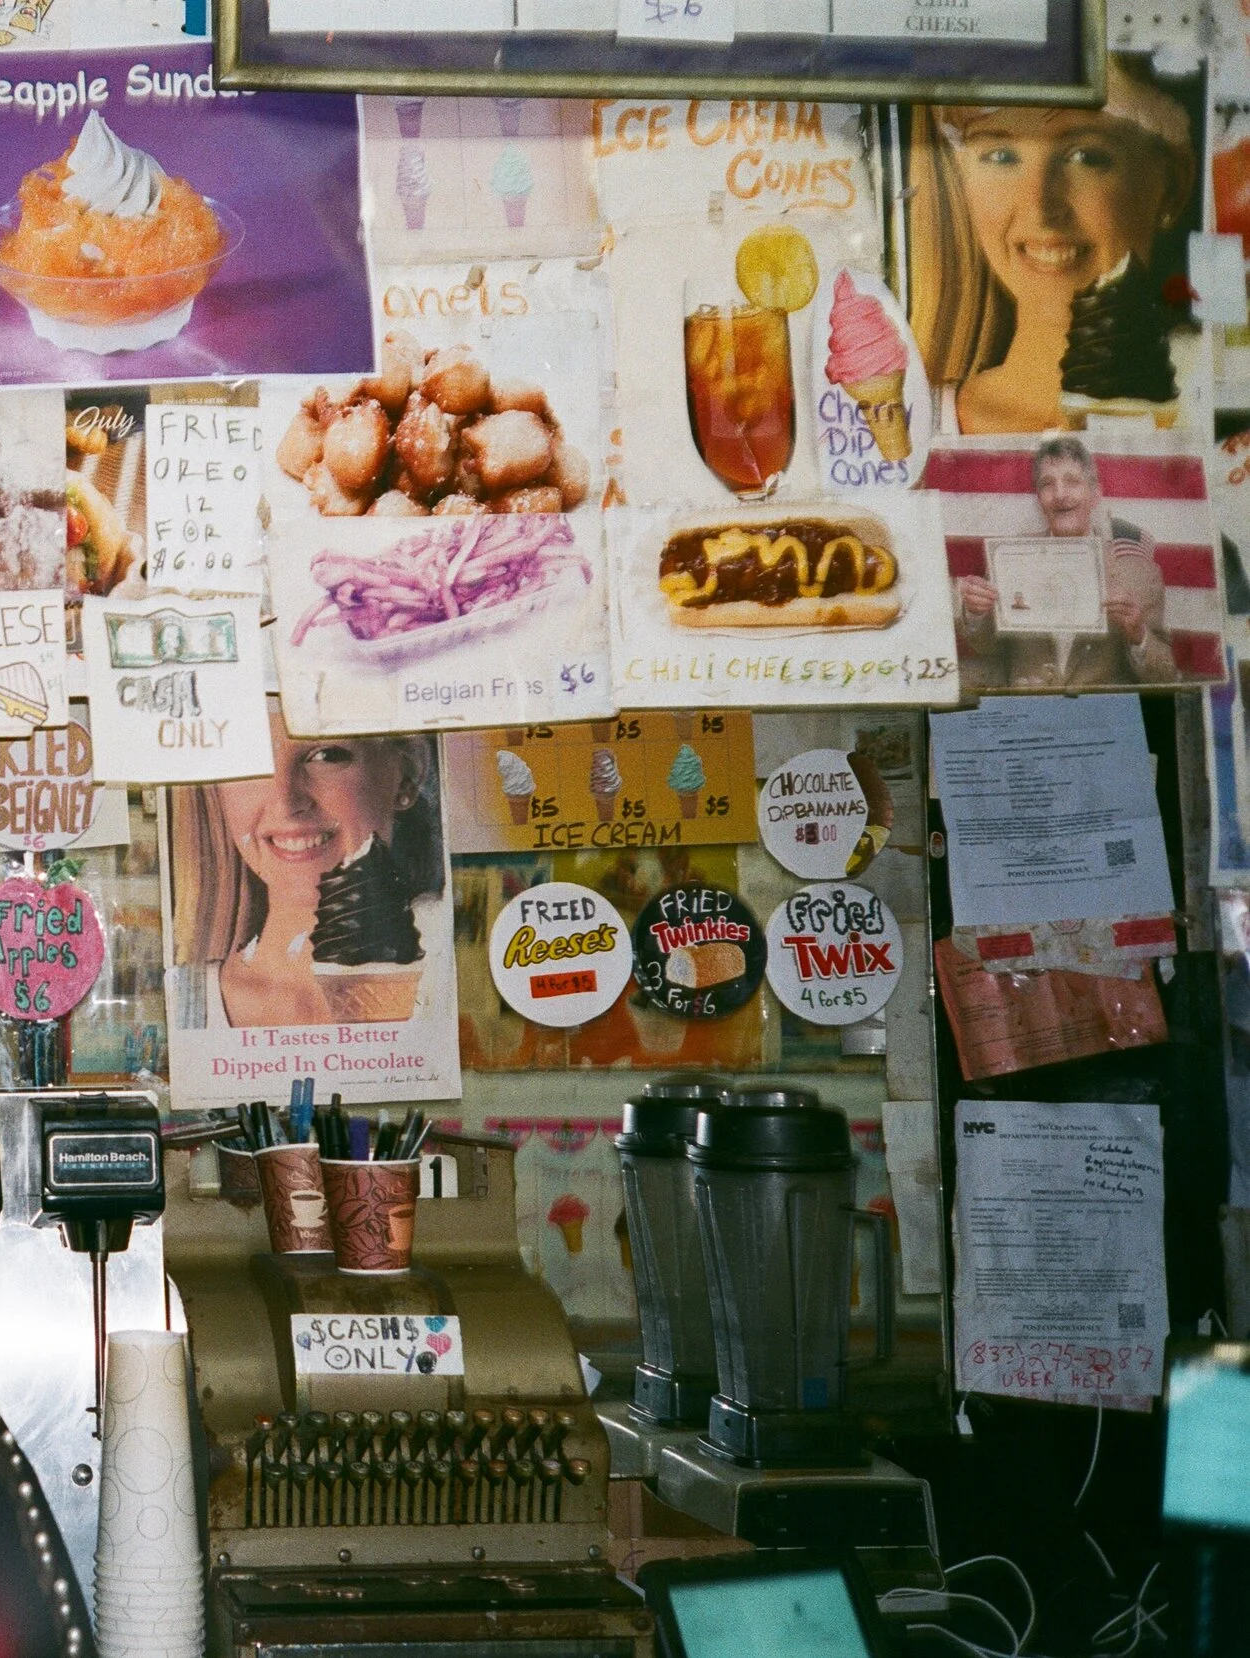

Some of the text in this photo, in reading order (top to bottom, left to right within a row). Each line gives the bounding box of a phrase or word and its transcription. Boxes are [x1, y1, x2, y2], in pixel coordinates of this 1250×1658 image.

[905, 15, 982, 34] CHEESE
[126, 63, 258, 98] Sund
[592, 100, 828, 158] ICE CREAM
[73, 405, 137, 438] July
[153, 456, 248, 483] OREO
[185, 493, 214, 514] 12
[404, 681, 485, 705] Belgian
[157, 719, 230, 748] ONLY
[616, 720, 642, 743] $5
[701, 713, 726, 735] $5
[768, 772, 855, 800] CHOCOLATE
[530, 795, 561, 819] $5
[620, 799, 647, 820] $5
[705, 795, 730, 816] $5
[533, 821, 681, 849] ICE CREAM
[520, 896, 597, 924] FRIED
[786, 889, 885, 936] Fried
[502, 922, 618, 969] Reese's
[650, 914, 751, 955] Twinkies
[780, 931, 898, 982] Twix
[646, 961, 664, 991] 3
[14, 979, 53, 1013] $6
[800, 987, 815, 1010] 4
[241, 1027, 400, 1047] It Tastes Better
[211, 1052, 425, 1081] Dipped In Chocolate
[963, 1120, 997, 1135] NYC
[59, 1152, 109, 1164] Hamilton
[429, 1155, 443, 1198] 1
[324, 1344, 417, 1374] ONLY
